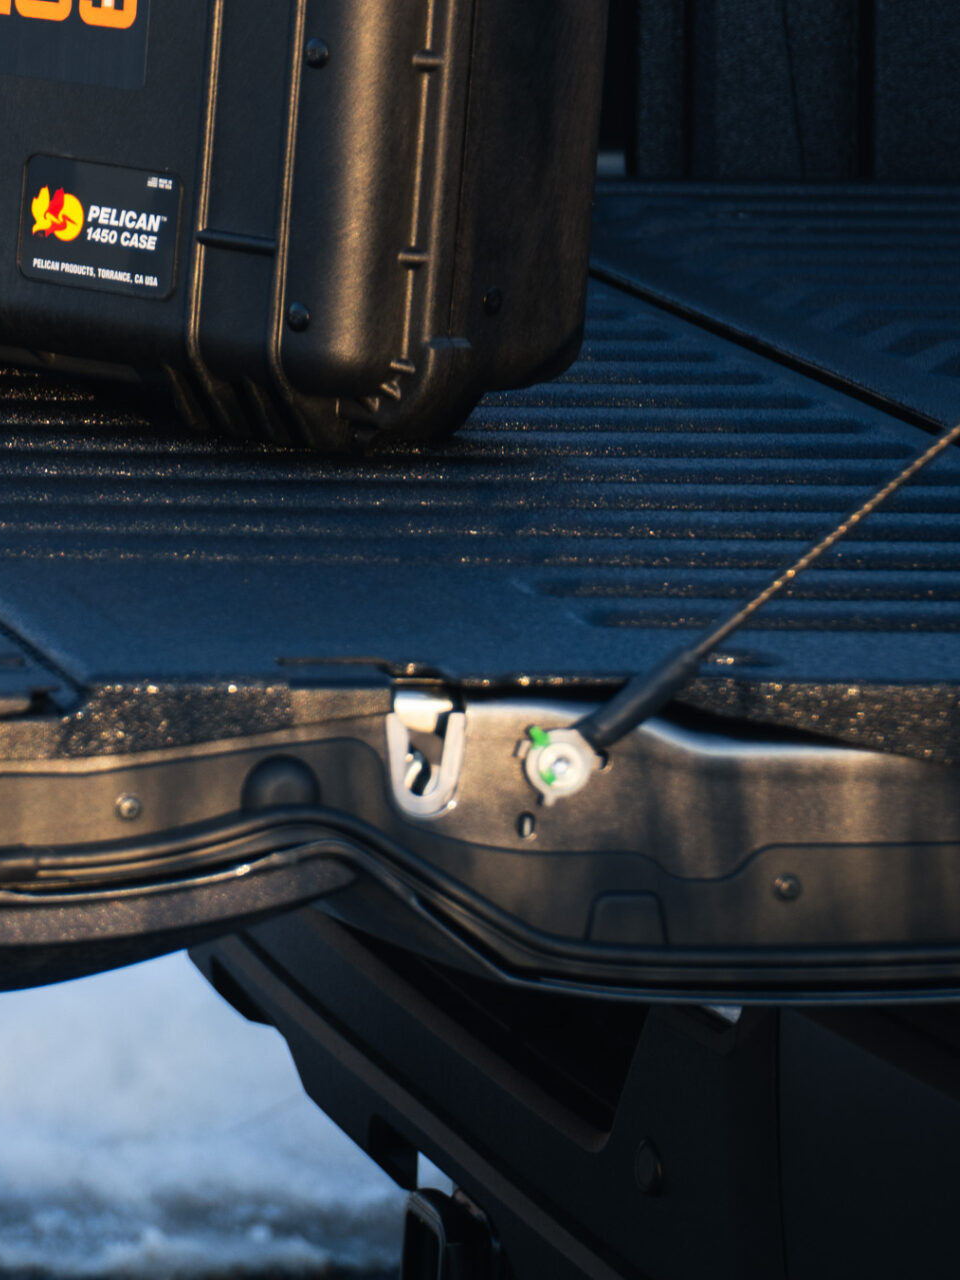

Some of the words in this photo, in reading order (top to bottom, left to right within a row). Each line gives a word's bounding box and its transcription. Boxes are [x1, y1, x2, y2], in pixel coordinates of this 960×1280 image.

[86, 227, 118, 244] 1450
[120, 231, 157, 251] CASE
[33, 258, 60, 271] PELICAN
[61, 262, 95, 277] PRODUCTS,
[98, 268, 133, 283] TORRANCE,
[135, 274, 144, 284] CA
[145, 276, 158, 287] USA
